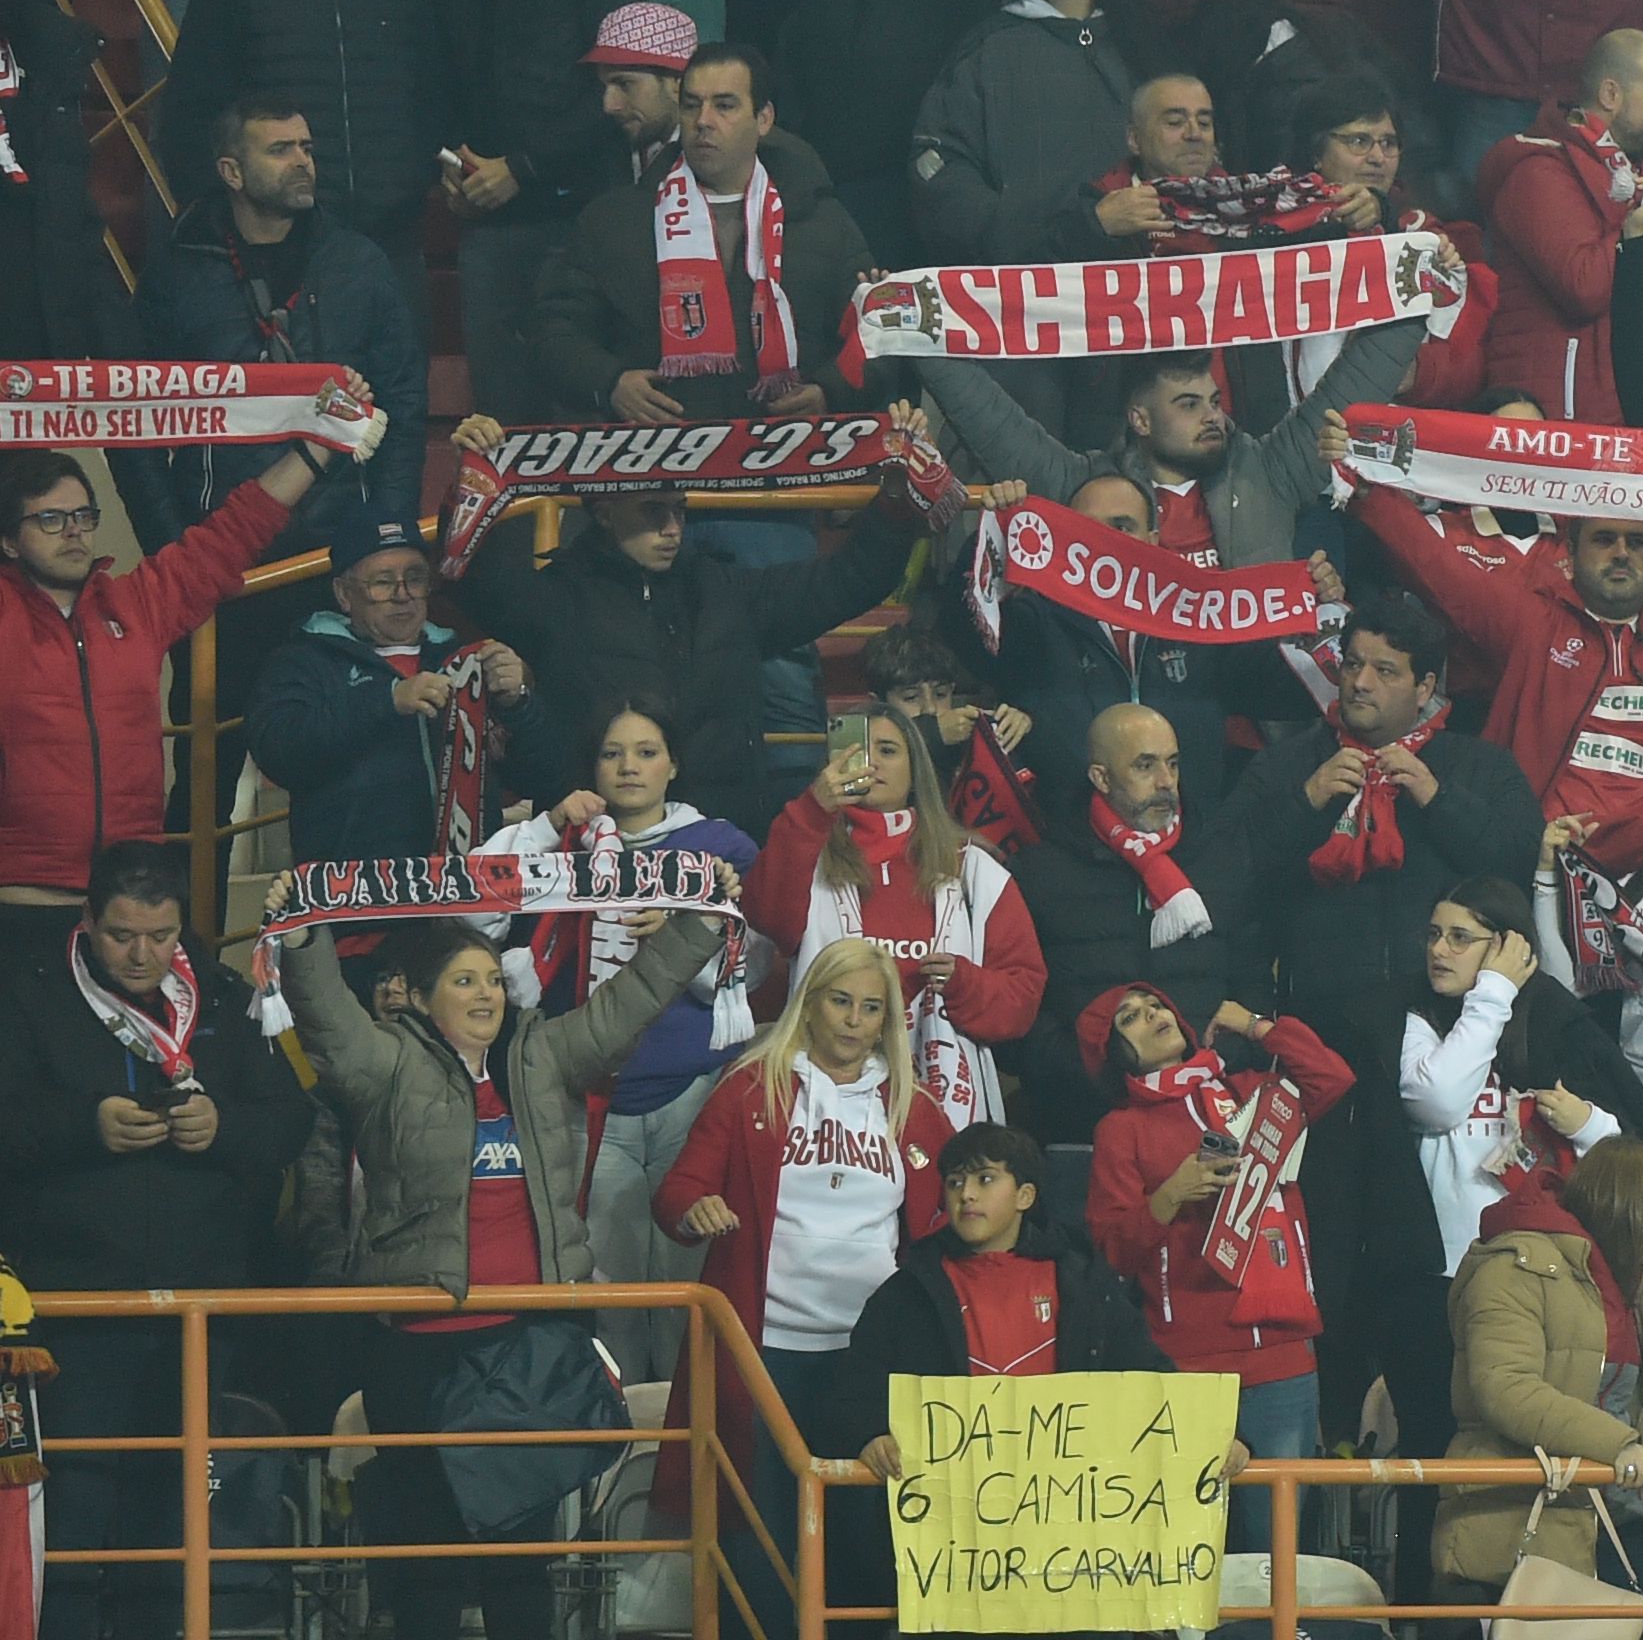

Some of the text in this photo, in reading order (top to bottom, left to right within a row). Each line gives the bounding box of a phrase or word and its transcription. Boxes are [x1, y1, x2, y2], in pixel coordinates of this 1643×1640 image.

[939, 238, 1397, 355] SC BRAGA
[105, 364, 247, 398] BRAGA
[12, 406, 228, 440] TI NÃO SEI VIVER
[491, 419, 877, 477] S.C. BRAGA
[1487, 426, 1632, 466] AMO-TE
[1480, 473, 1538, 500] SEM
[1541, 479, 1567, 503] TI
[1574, 480, 1627, 507] NÃO
[1061, 541, 1316, 632] SOLVERDE.P
[474, 1140, 522, 1170] AXA
[816, 1116, 898, 1186] BRAGA
[1224, 1153, 1270, 1240] 12
[921, 1382, 1180, 1466] DÁ-ME A
[895, 1483, 932, 1526] 6
[1195, 1455, 1222, 1506] 6
[1042, 1542, 1216, 1595] CARVALHO
